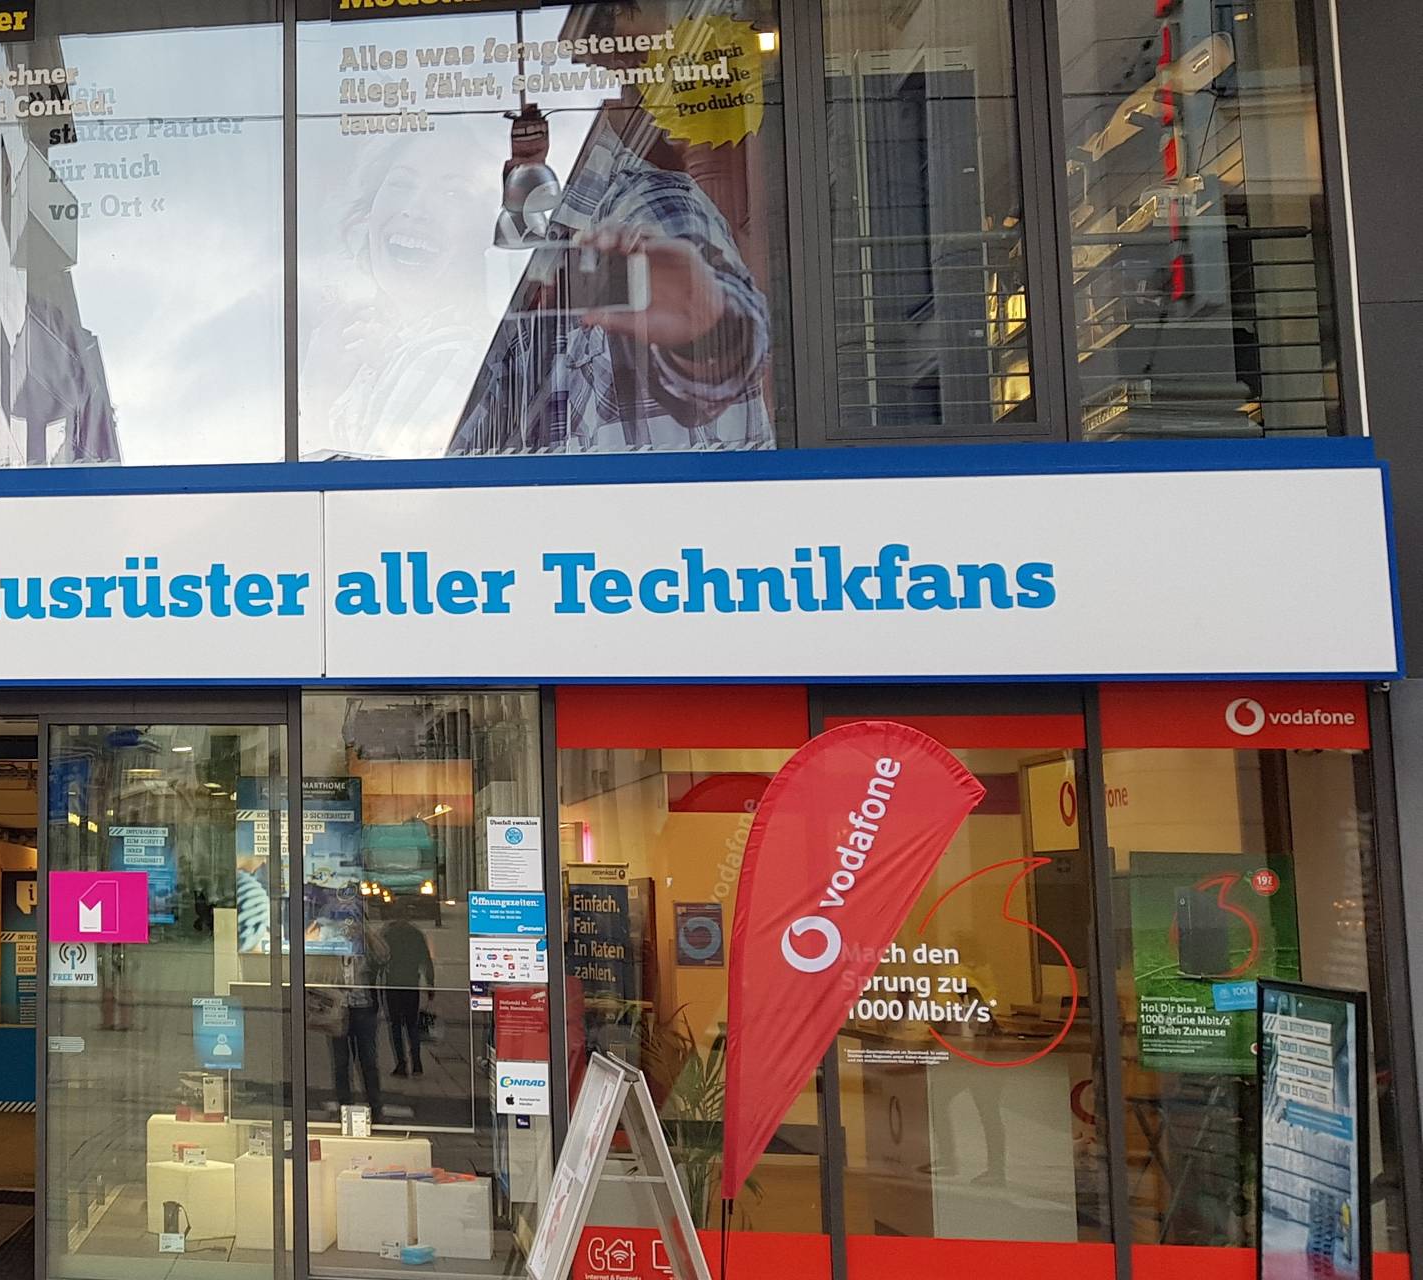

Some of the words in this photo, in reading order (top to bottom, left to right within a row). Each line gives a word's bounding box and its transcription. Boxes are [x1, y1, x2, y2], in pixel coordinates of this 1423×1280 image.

[339, 46, 408, 72] Alles
[416, 47, 475, 67] was
[482, 29, 675, 67] ferngesteuert
[703, 42, 745, 62] auch
[339, 75, 417, 108] fliegt,
[425, 71, 502, 101] fährt,
[512, 64, 664, 95] schwimmt
[672, 56, 730, 83] und
[14, 90, 113, 118] Conrad.
[676, 91, 755, 118] Produkte
[49, 121, 139, 145] starker
[147, 117, 244, 138] Partner
[340, 108, 435, 136] taucht.
[49, 159, 86, 183] für
[93, 153, 160, 180] mich
[49, 202, 92, 220] vor
[100, 194, 142, 217] Ort
[335, 551, 516, 616] aller
[542, 543, 1057, 615] Technikfans
[1269, 708, 1356, 726] vodafone
[303, 781, 346, 790] MARTHOME
[1105, 787, 1129, 808] one
[820, 755, 902, 909] vodafone
[471, 895, 540, 908] Öffnungszeiten:
[573, 894, 620, 913] Einfach.
[573, 916, 598, 935] Fair.
[574, 940, 587, 957] In
[590, 940, 625, 959] Raten
[842, 942, 907, 964] Mach
[913, 943, 960, 964] den
[52, 973, 73, 981] FREE
[74, 973, 95, 981] WIFI
[575, 962, 616, 982] zahlen.
[841, 970, 931, 997] Sprung
[937, 976, 968, 993] zu
[846, 998, 904, 1021] 1000
[1141, 1004, 1159, 1013] Hol
[1161, 1004, 1175, 1013] Dir
[1177, 1004, 1192, 1014] bis
[1194, 1006, 1206, 1014] zu
[1140, 1014, 1164, 1024] 1000
[1165, 1015, 1195, 1026] grüne
[1142, 1026, 1157, 1035] für
[1159, 1027, 1182, 1036] Dein
[1183, 1027, 1226, 1037] Zuhause
[500, 1076, 546, 1088] CONRAD
